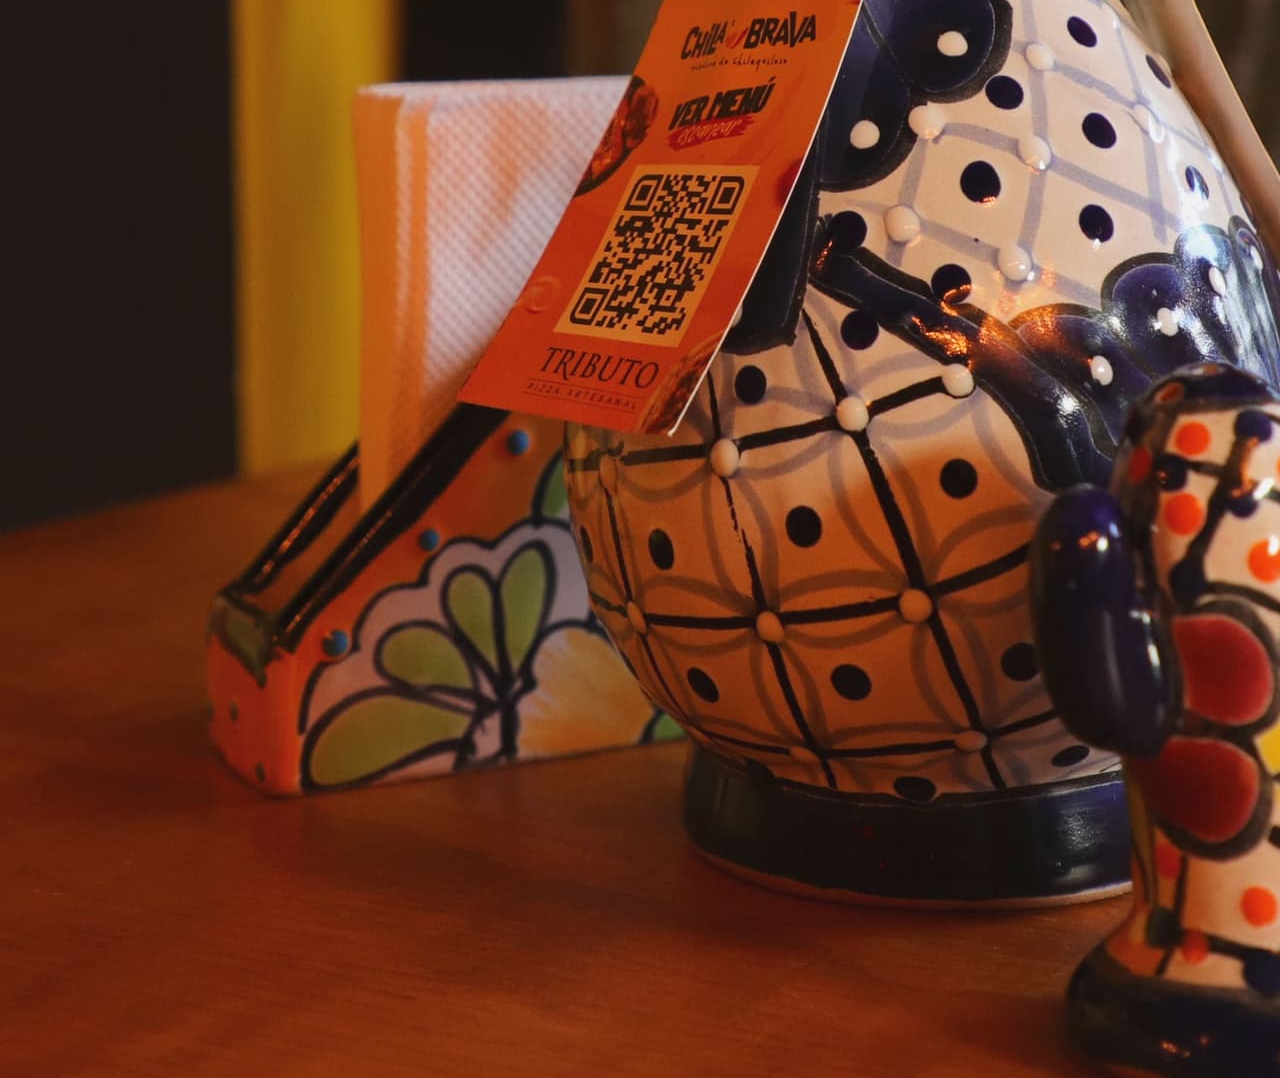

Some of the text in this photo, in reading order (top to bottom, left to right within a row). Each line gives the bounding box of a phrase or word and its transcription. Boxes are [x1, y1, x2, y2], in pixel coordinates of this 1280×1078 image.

[744, 11, 816, 49] BRAVA
[668, 76, 776, 131] VER MENÚ
[540, 347, 660, 389] TRIBUTO
